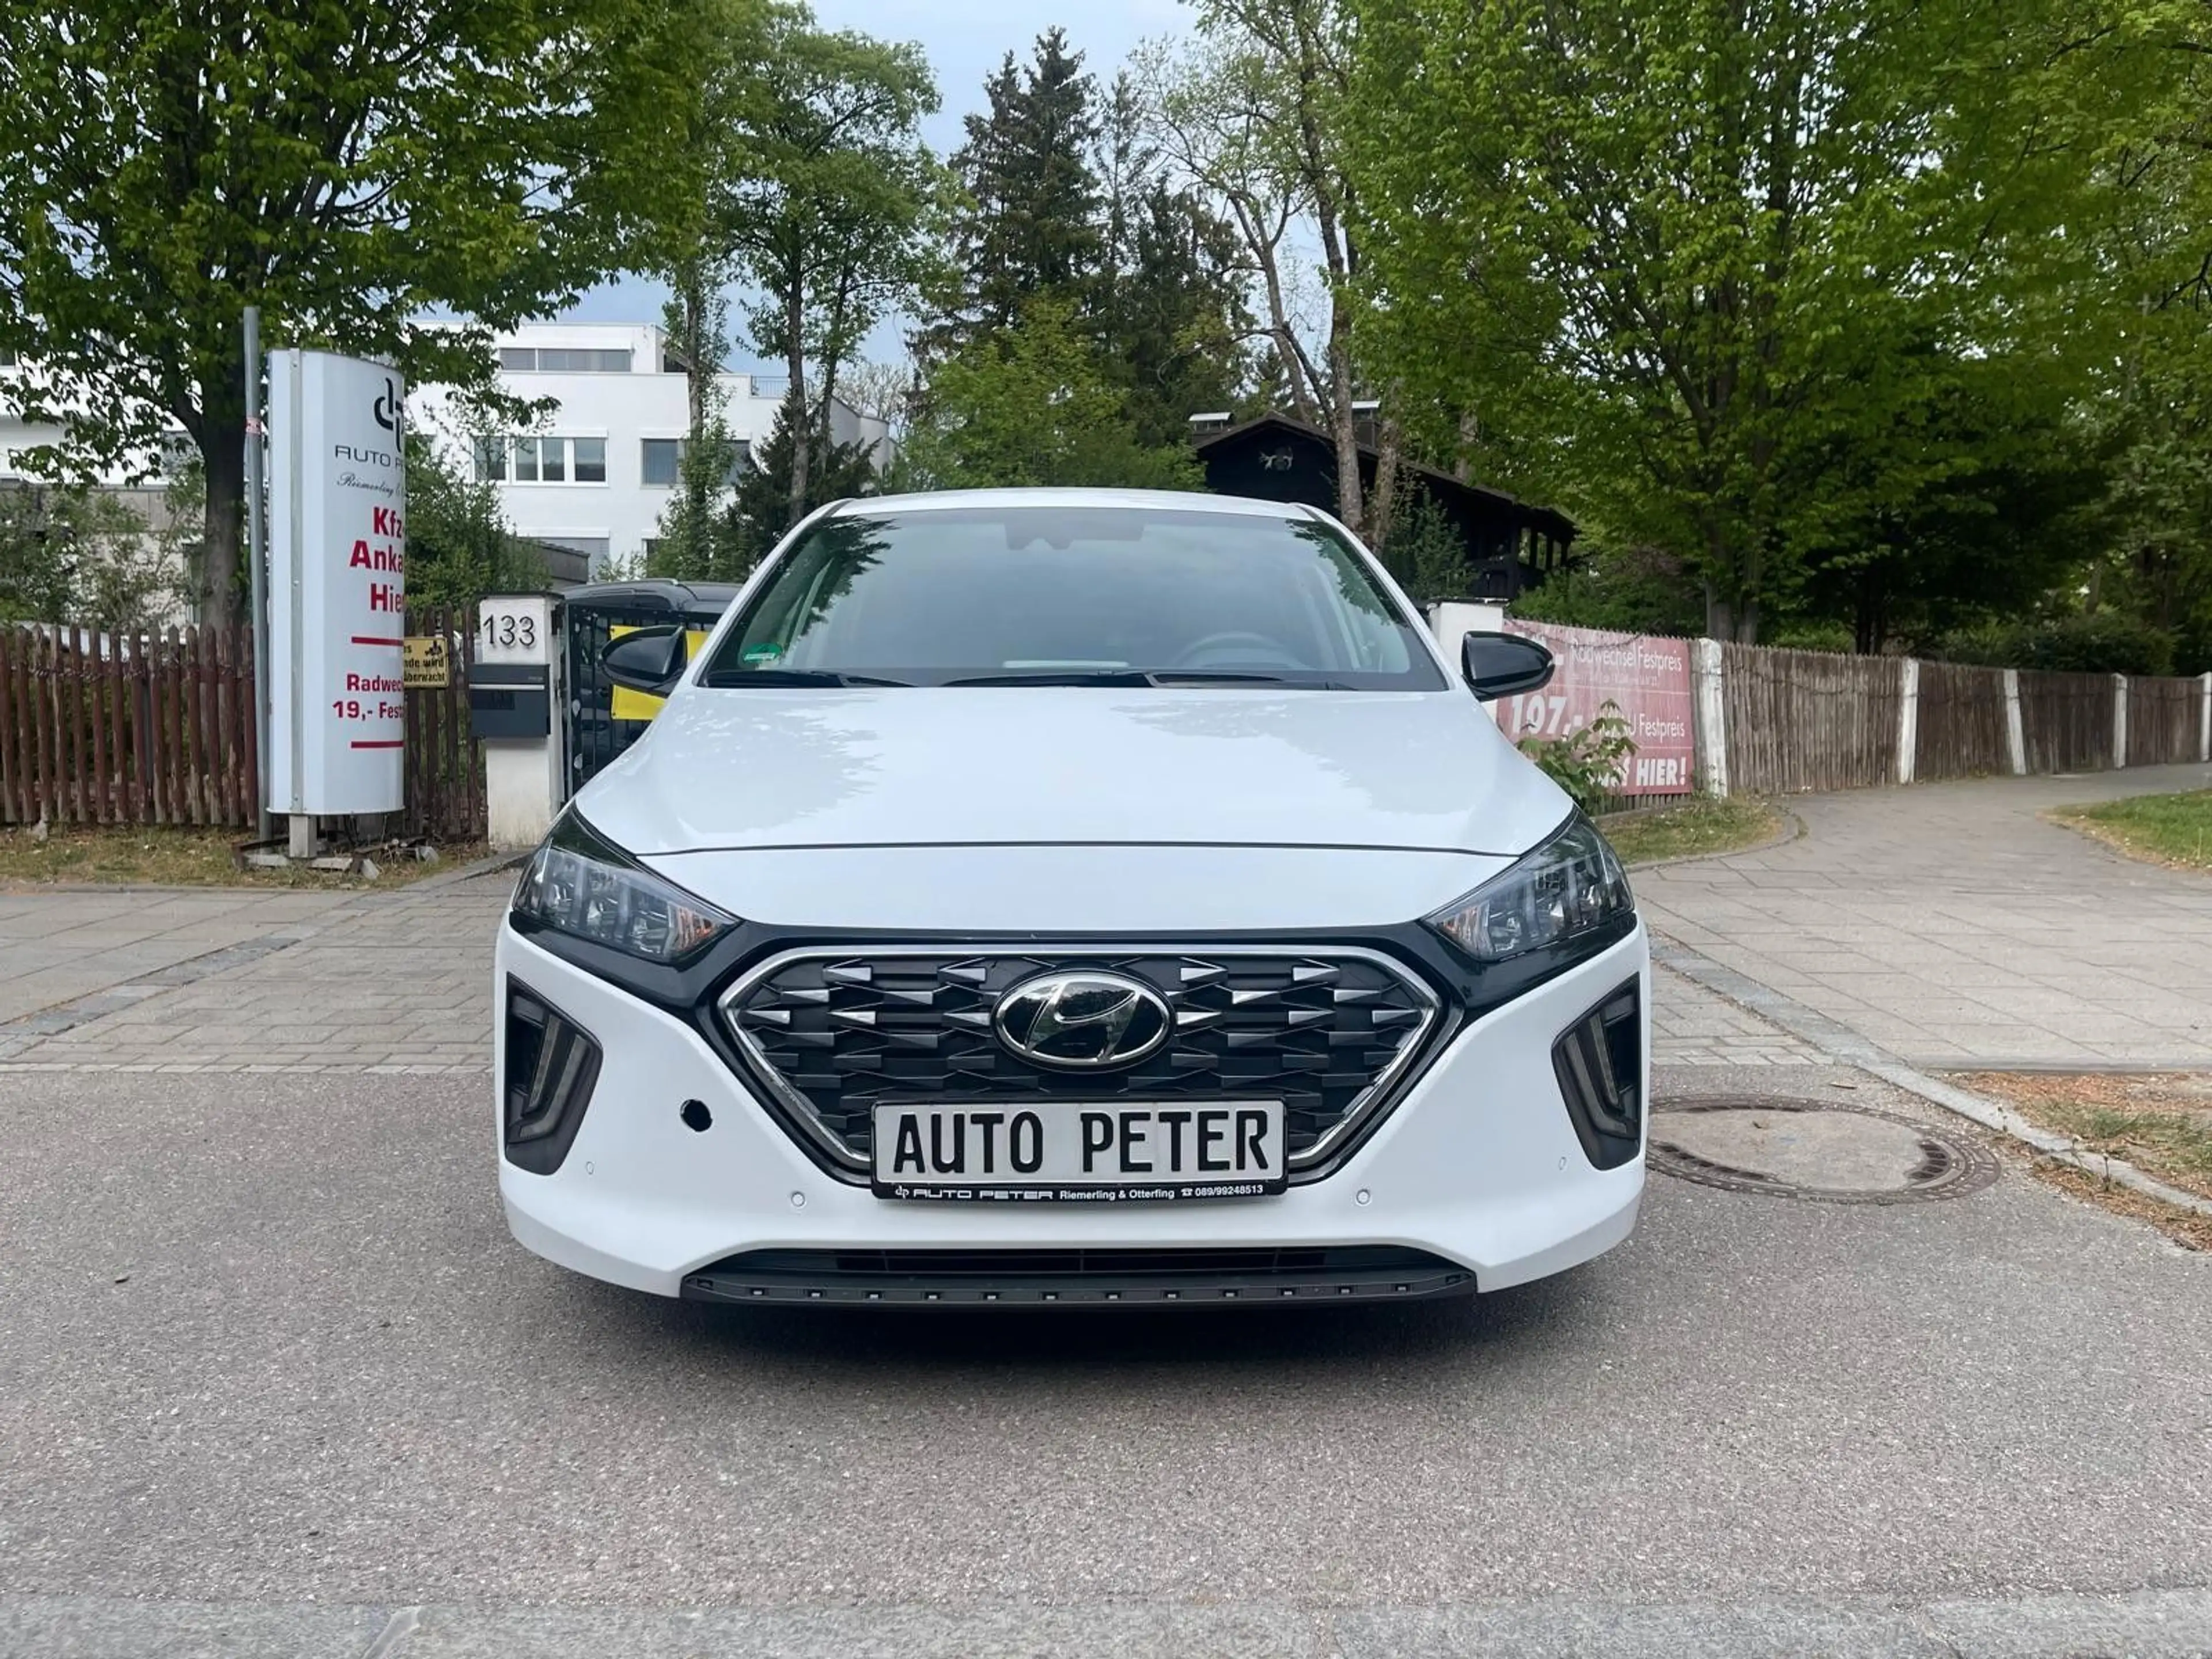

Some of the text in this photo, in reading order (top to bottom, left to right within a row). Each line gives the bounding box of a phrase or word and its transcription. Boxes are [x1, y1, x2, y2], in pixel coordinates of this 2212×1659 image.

[335, 445, 391, 467] AUTO
[483, 614, 535, 646] 133
[1571, 638, 1637, 666] Radwechsel
[1638, 646, 1683, 677] Festpreis
[332, 700, 373, 721] 19,-
[1510, 694, 1584, 741] 197,-
[1639, 713, 1685, 744] Festpreis
[1636, 756, 1687, 787] HIER!
[892, 1109, 1270, 1175] AUTO PETER
[914, 1188, 972, 1199] AUTO
[979, 1190, 1054, 1200] PETER
[1060, 1190, 1115, 1201] Riemerling
[1118, 1190, 1126, 1199] &
[1129, 1188, 1175, 1200] Otterfing
[1194, 1184, 1264, 1197] 089/99248513
